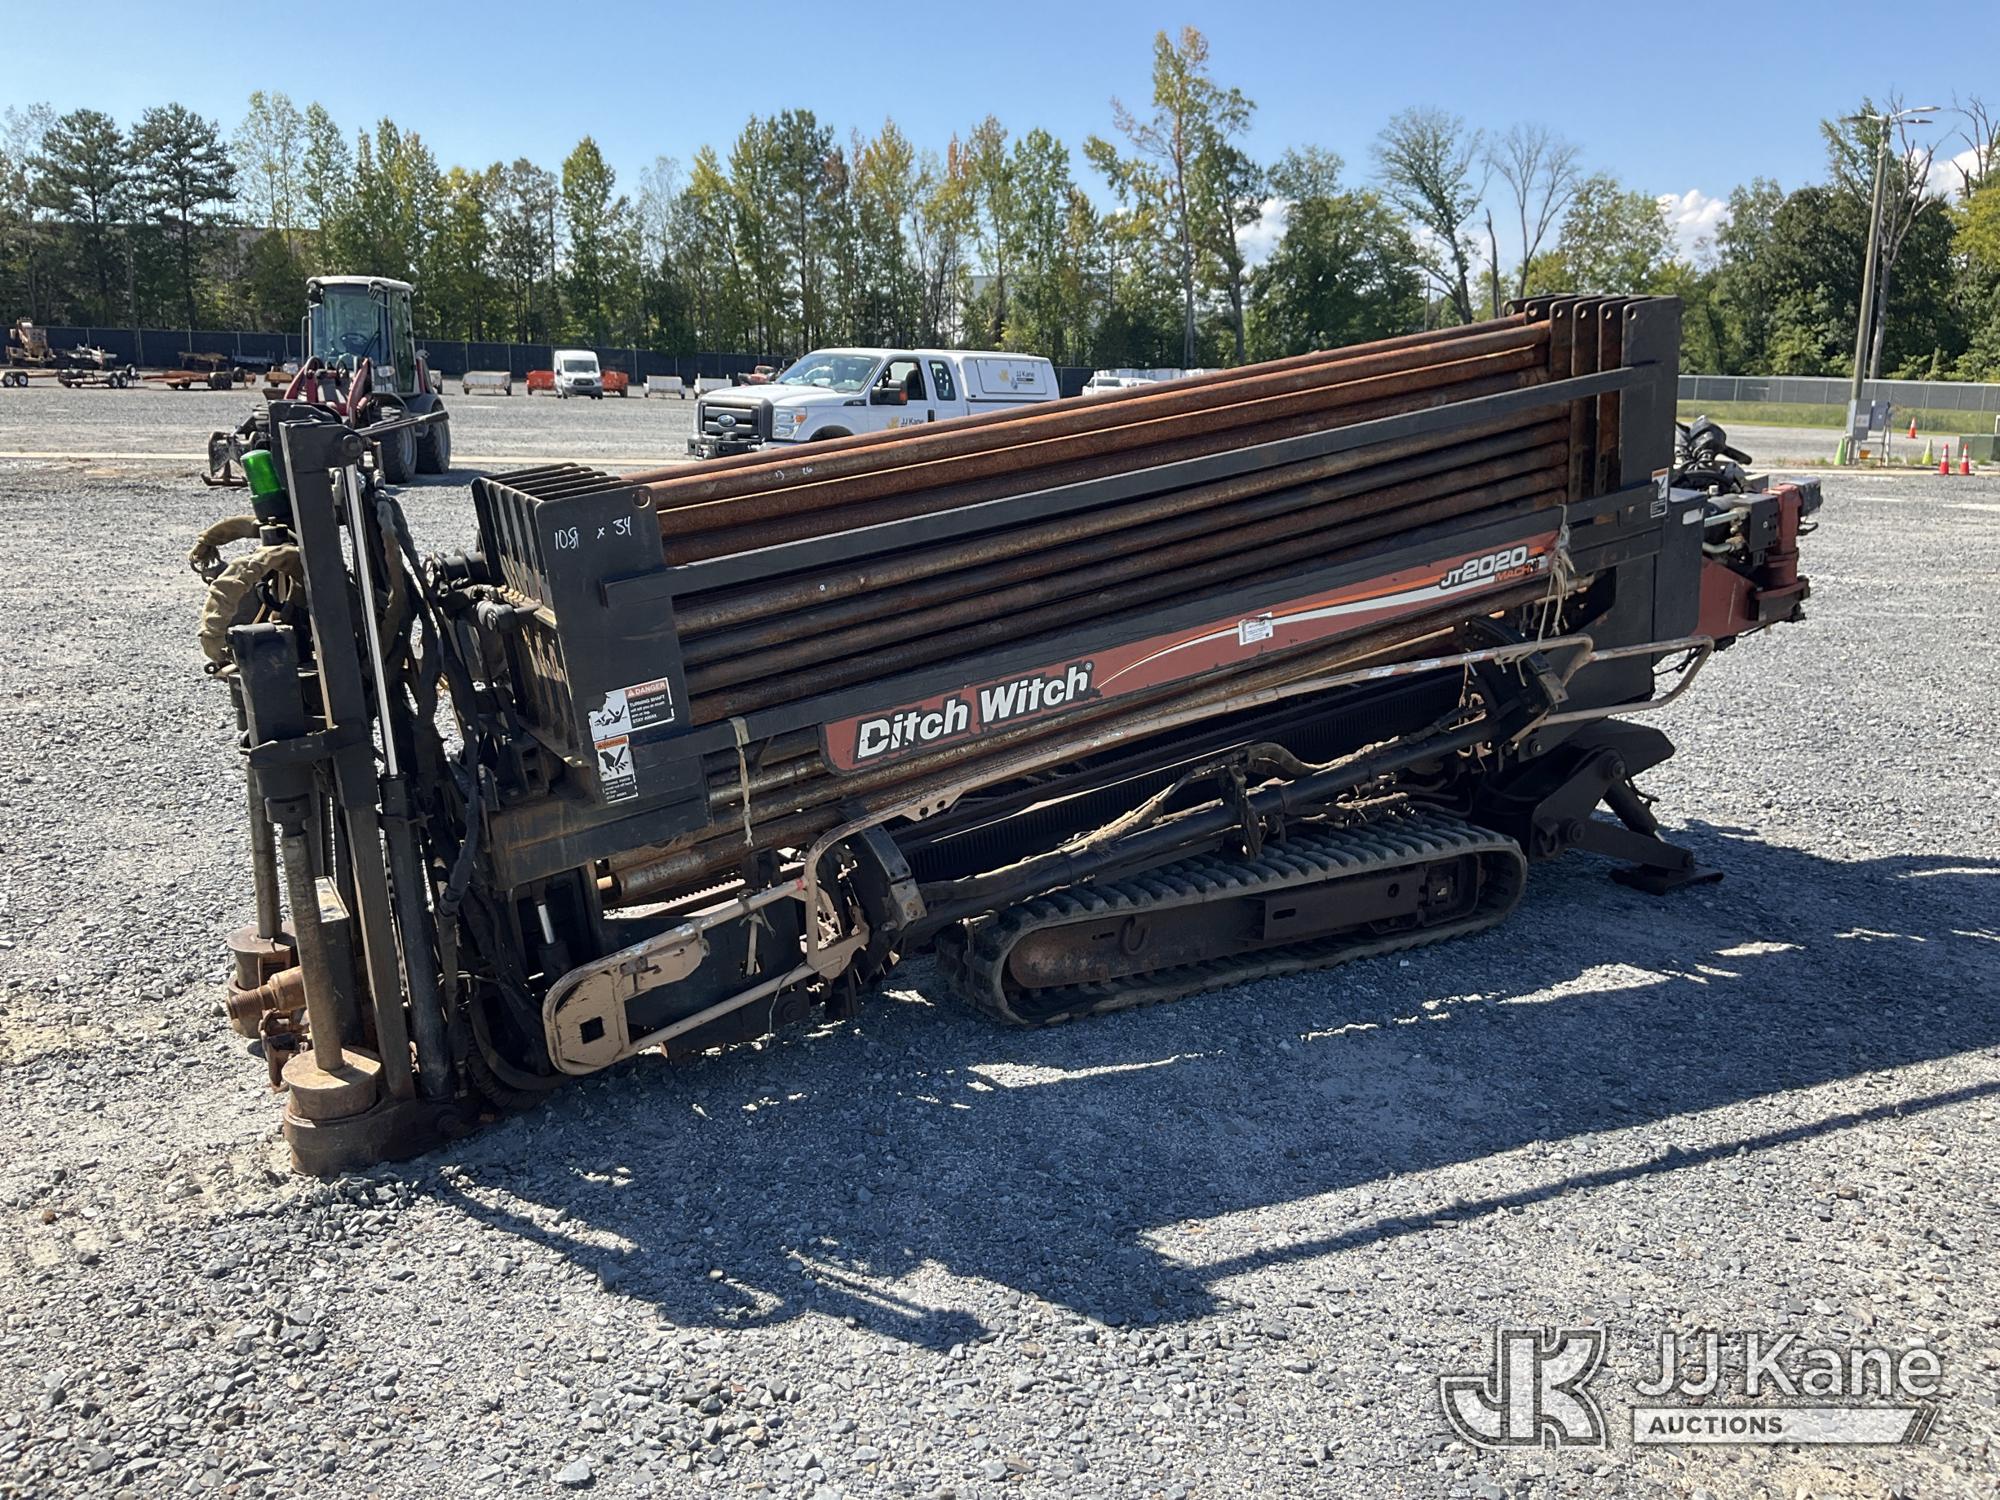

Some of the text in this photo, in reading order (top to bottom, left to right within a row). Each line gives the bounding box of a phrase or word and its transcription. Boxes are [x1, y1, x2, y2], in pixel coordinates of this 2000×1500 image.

[613, 516, 632, 536] 34
[1441, 546, 1528, 587] JT2020
[635, 681, 666, 695] DANGER
[858, 666, 1088, 758] Ditch Witch
